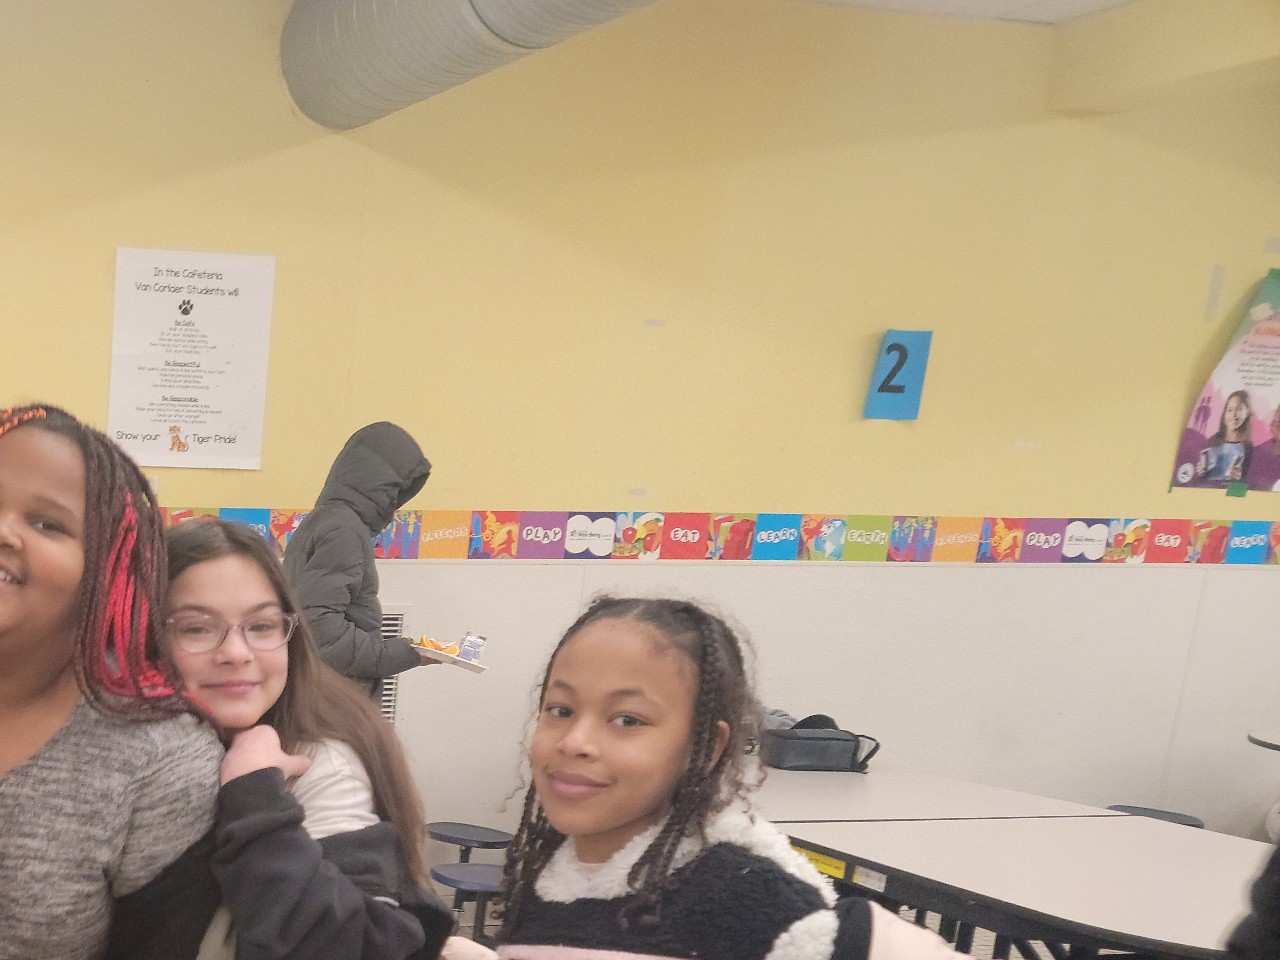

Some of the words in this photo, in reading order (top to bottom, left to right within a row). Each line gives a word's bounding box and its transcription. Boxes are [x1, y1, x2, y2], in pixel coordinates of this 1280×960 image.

[153, 266, 164, 277] In
[166, 267, 180, 278] the
[182, 268, 223, 280] Cafeteria
[135, 281, 152, 292] Van
[186, 284, 225, 296] Students
[877, 342, 909, 394] 2
[116, 430, 138, 441] Show
[140, 433, 161, 443] your
[192, 433, 212, 445] Tiger
[214, 434, 237, 445] Pride!
[524, 526, 562, 544] PLAY
[671, 527, 700, 542] EAT
[757, 528, 798, 543] LEARN
[848, 530, 888, 544] EARTH
[1027, 532, 1062, 549] PLAY
[1155, 533, 1182, 547] EAT
